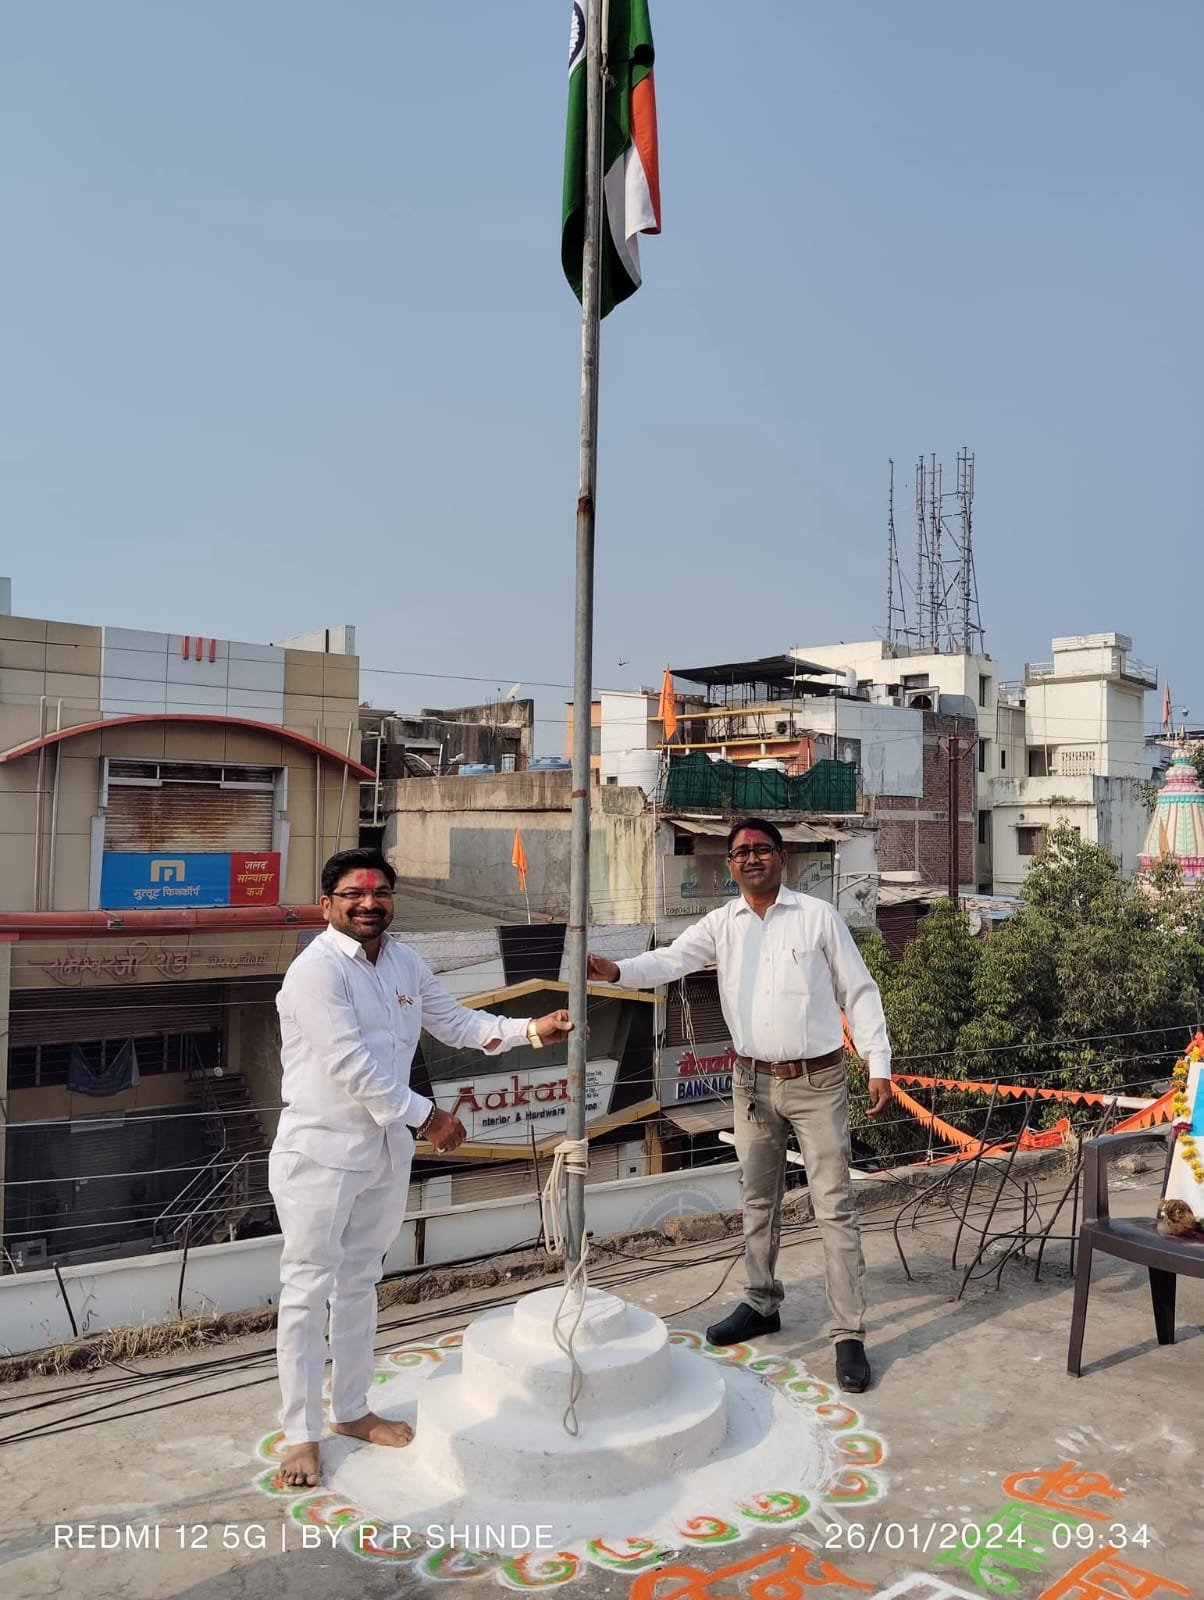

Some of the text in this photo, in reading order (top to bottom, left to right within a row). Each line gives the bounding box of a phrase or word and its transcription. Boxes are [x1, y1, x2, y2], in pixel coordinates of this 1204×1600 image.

[244, 861, 268, 870] जलद
[237, 870, 275, 883] सोन्यावर
[246, 883, 265, 896] कर्ज
[515, 1112, 522, 1122] &
[525, 1107, 566, 1120] Hardware
